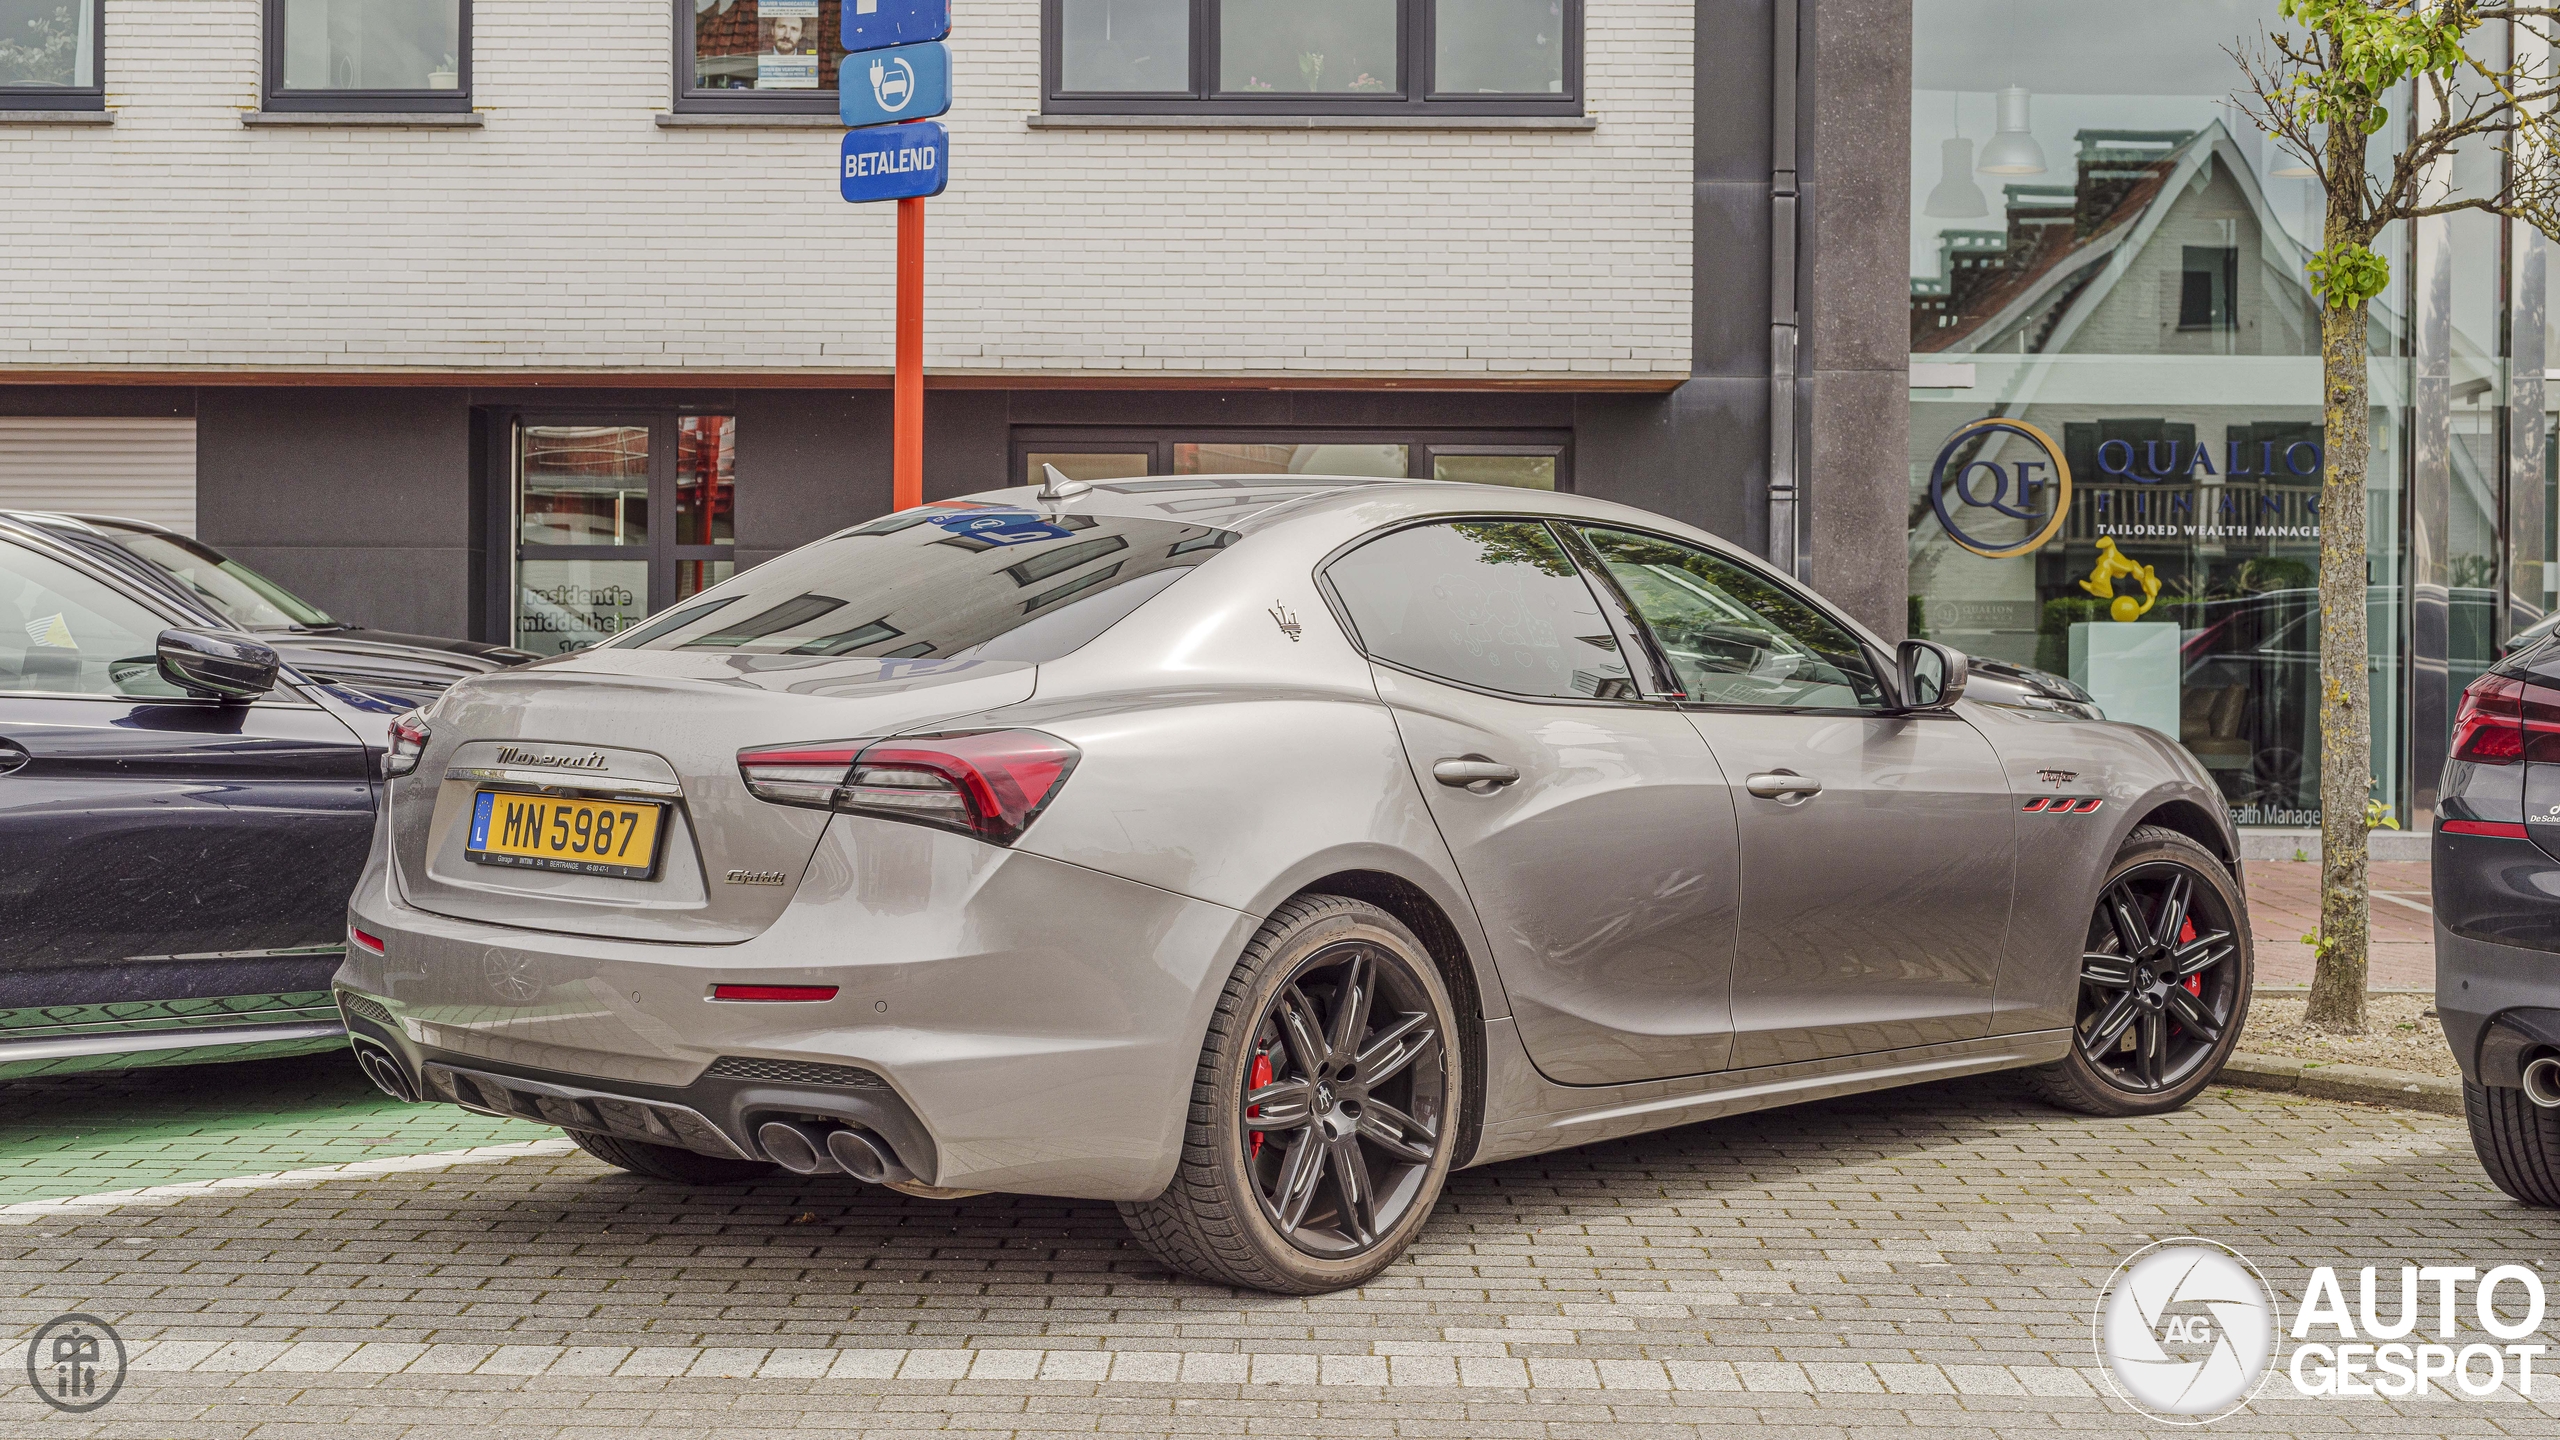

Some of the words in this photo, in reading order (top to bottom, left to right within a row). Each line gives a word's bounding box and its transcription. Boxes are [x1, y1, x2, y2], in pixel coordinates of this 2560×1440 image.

[845, 146, 935, 178] BETALEND
[2097, 439, 2323, 484] QUALIO
[1957, 460, 2047, 519] QF
[2097, 524, 2178, 537] TAILORED
[2184, 525, 2248, 537] WEALTH
[2254, 525, 2320, 537] MANAGE
[526, 585, 633, 606] residentie
[517, 612, 641, 633] middelheim
[496, 745, 609, 771] Maserati
[2264, 803, 2321, 829] Manage
[476, 827, 483, 842] L
[502, 802, 546, 849] MN
[550, 806, 639, 857] 5987
[497, 855, 513, 864] Garage
[549, 860, 580, 870] BERTRANGE
[724, 869, 786, 886] Ghibli
